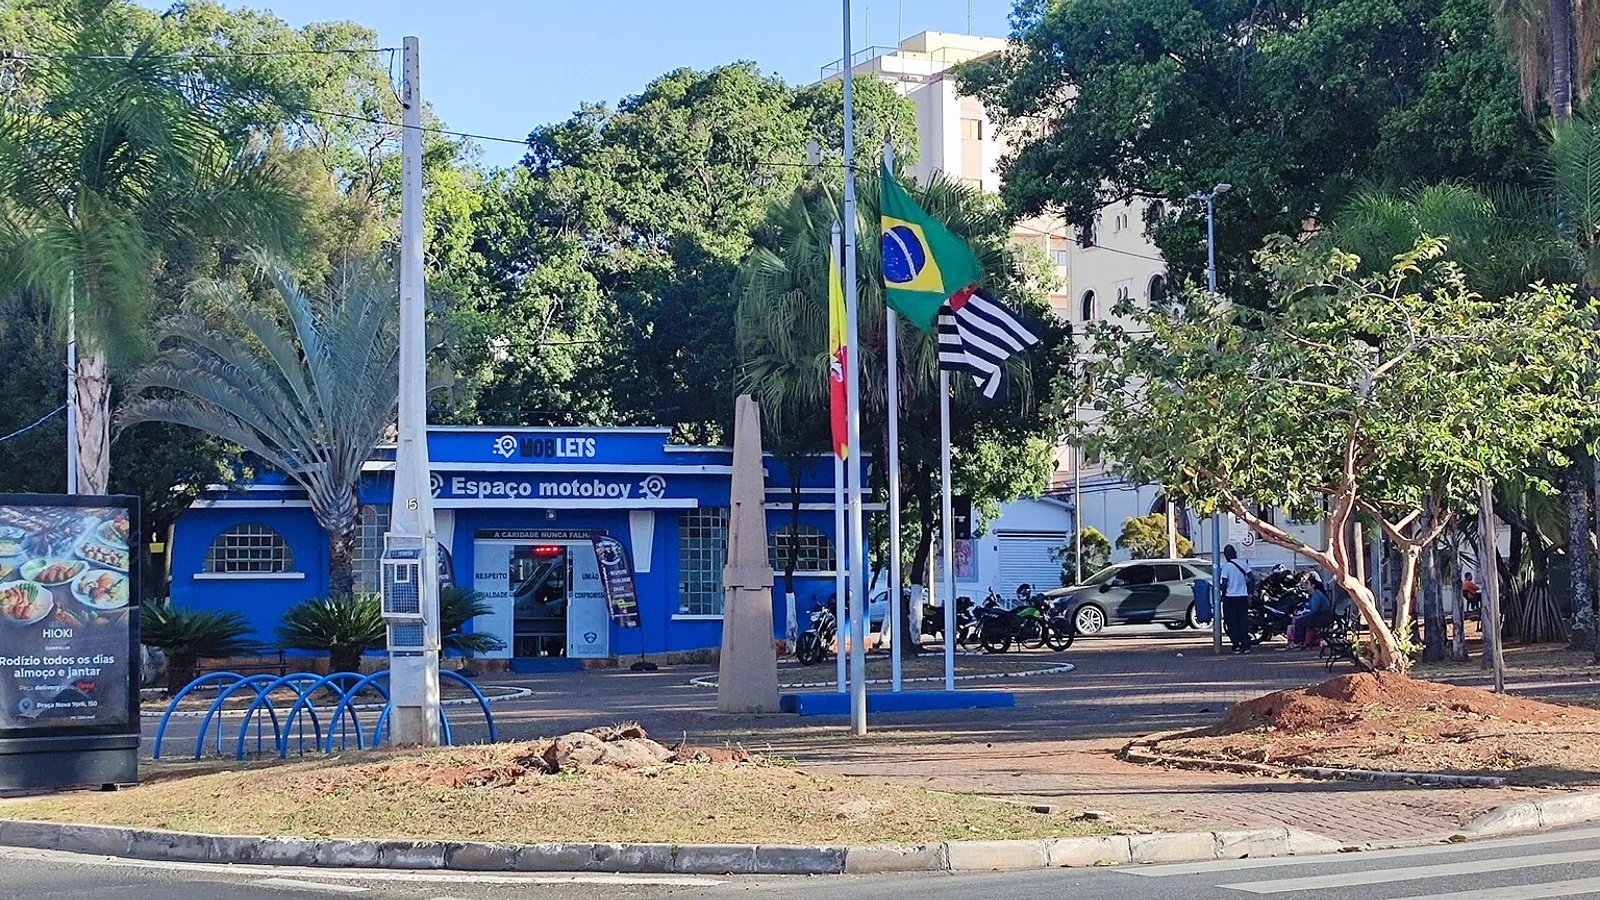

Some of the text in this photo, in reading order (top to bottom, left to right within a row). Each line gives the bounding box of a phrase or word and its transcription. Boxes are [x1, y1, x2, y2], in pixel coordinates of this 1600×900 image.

[519, 437, 596, 458] MOBLETS
[451, 477, 632, 499] Espaço motoboy
[405, 498, 418, 511] 15
[475, 572, 508, 580] RESPEITO
[582, 571, 600, 580] UNIÃO
[42, 628, 73, 638] HIOKI
[0, 654, 115, 666] Rodízio todos os dias
[14, 666, 101, 680] almoço e jantar
[34, 684, 61, 692] delivery
[36, 701, 55, 709] Praça
[55, 701, 71, 709] Nova
[88, 700, 98, 708] 150
